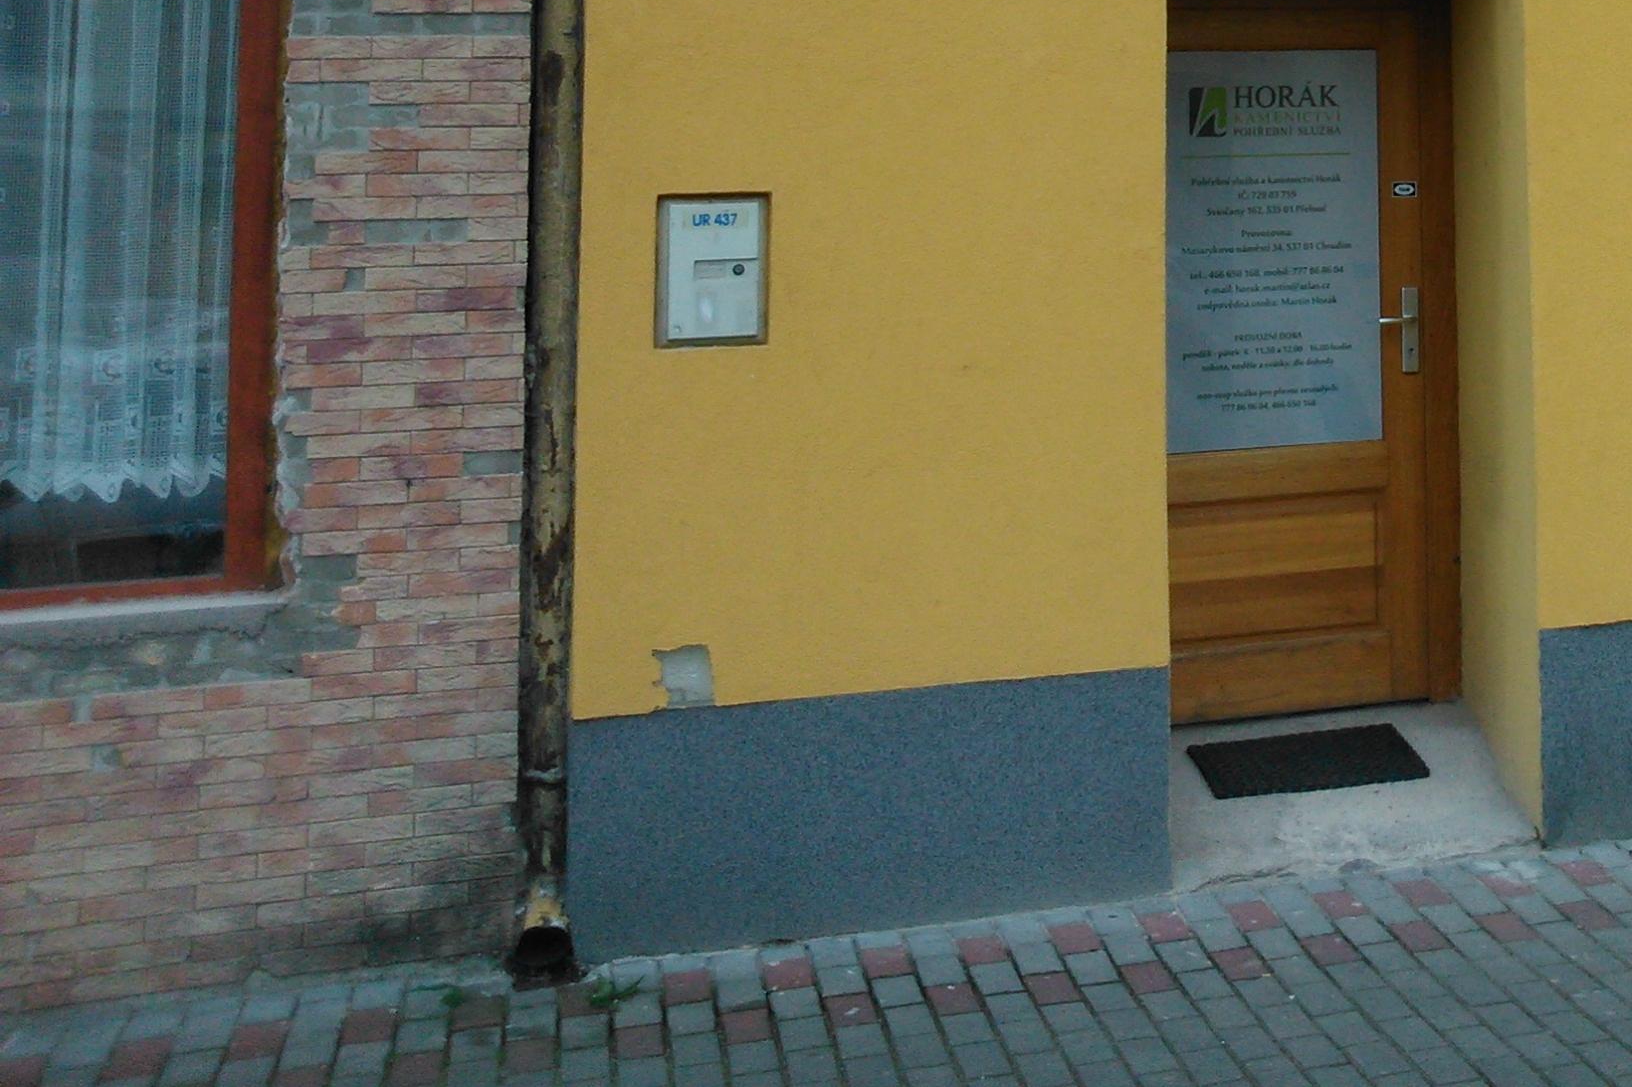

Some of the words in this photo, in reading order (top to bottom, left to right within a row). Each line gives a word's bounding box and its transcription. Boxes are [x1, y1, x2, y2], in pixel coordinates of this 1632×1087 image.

[1233, 81, 1340, 108] HORÁK
[692, 214, 711, 227] UR
[714, 213, 738, 227] 437
